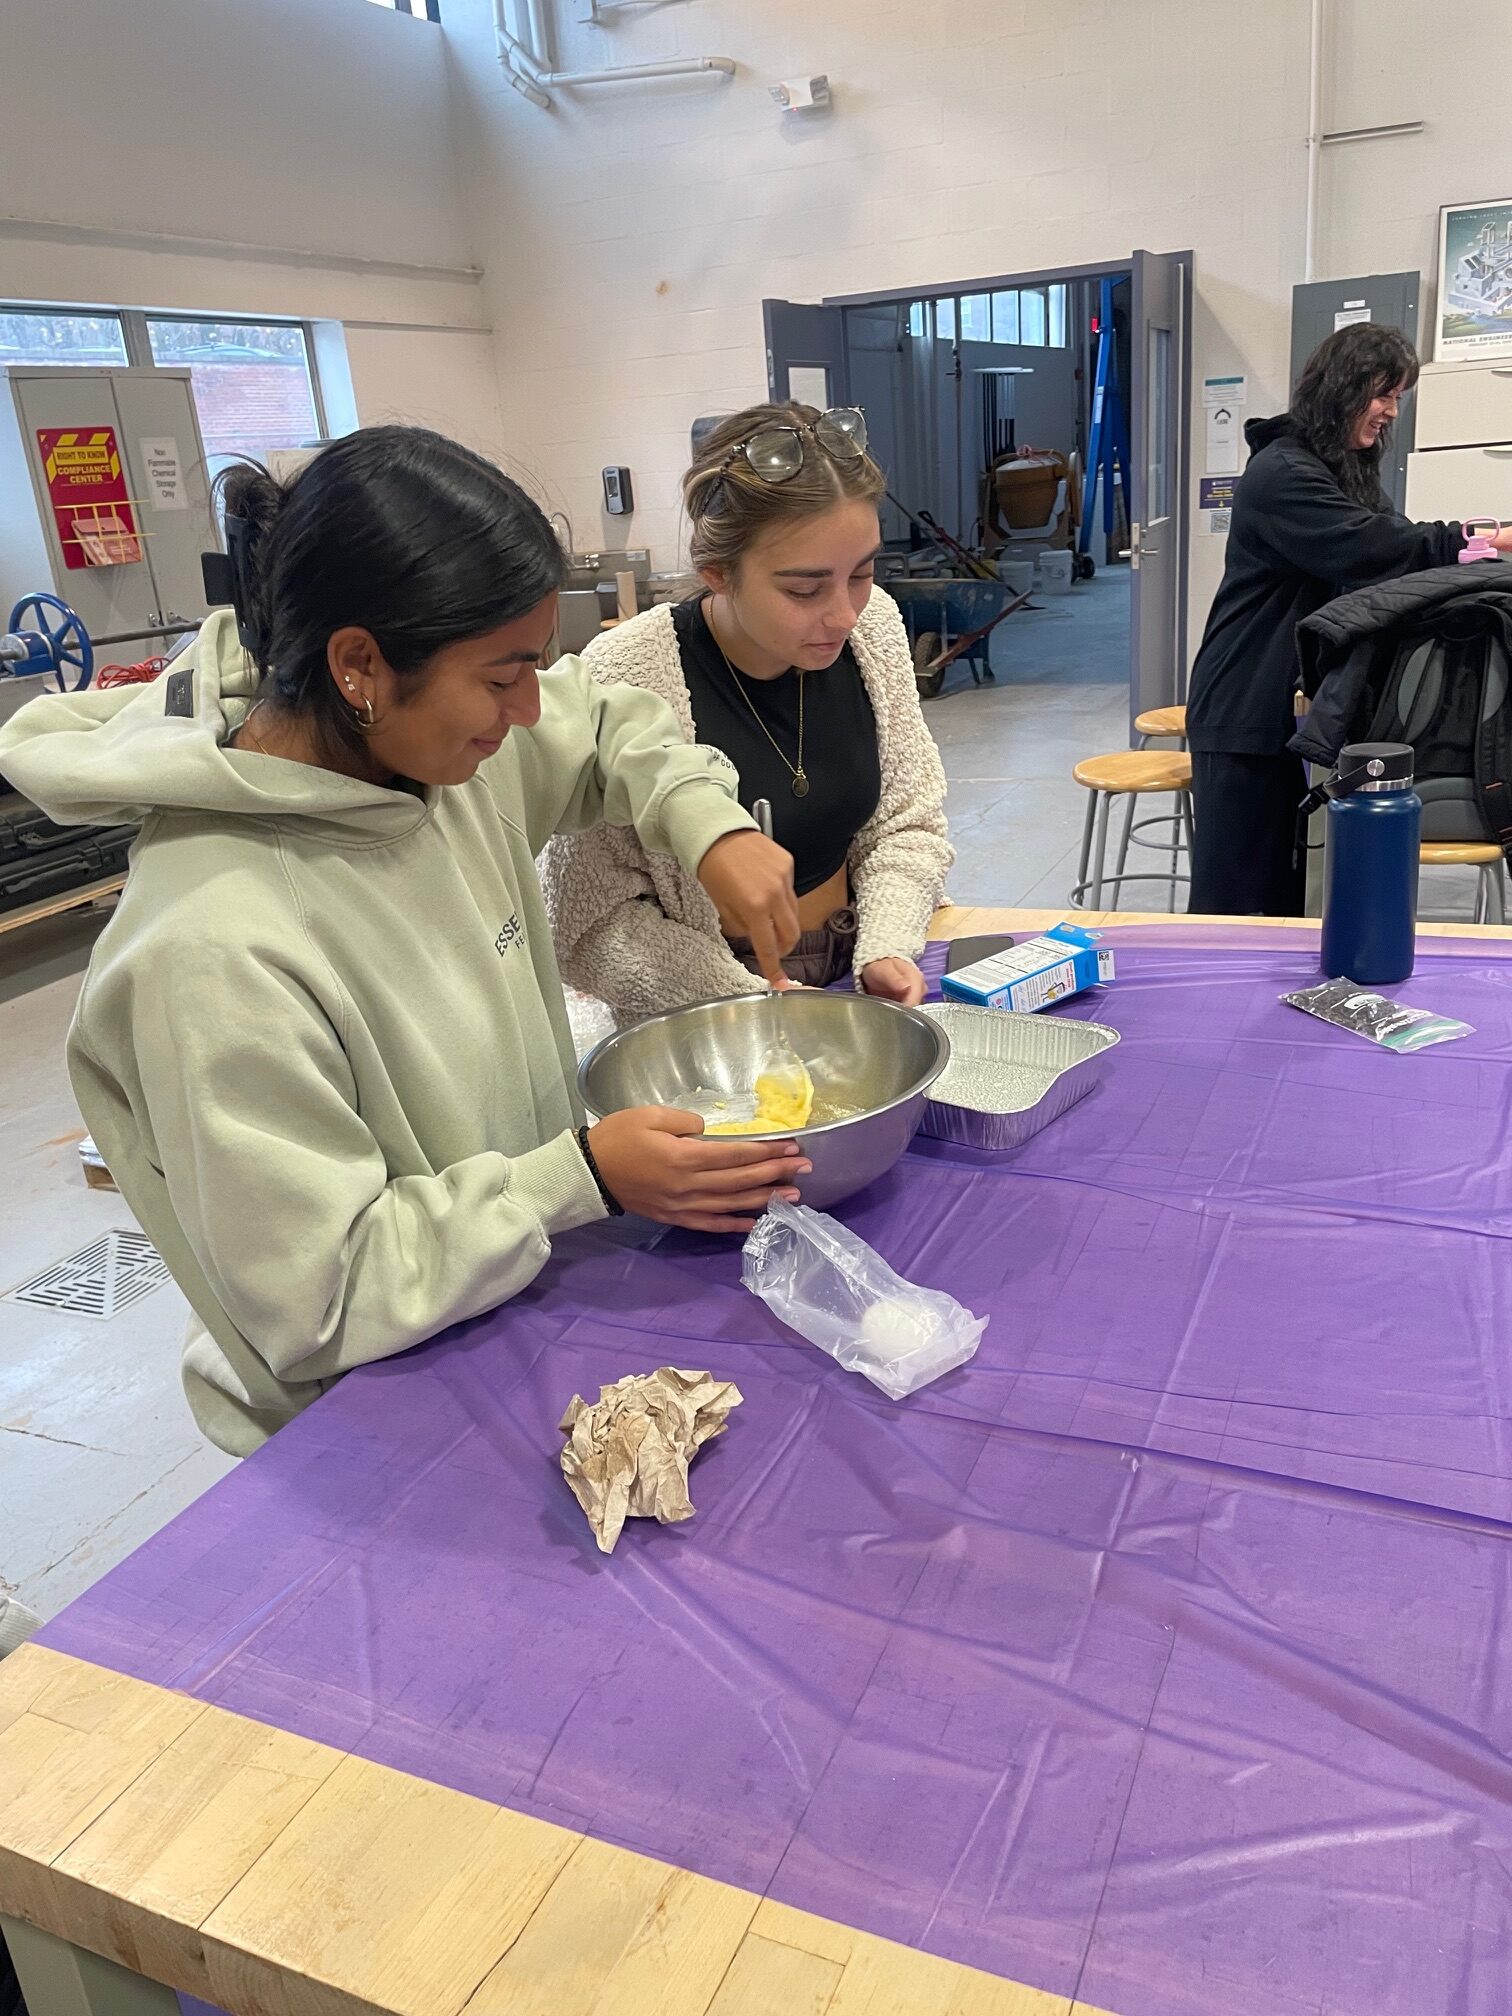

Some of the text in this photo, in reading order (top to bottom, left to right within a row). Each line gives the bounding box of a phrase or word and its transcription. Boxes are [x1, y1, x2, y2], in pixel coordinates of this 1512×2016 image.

[77, 451, 87, 459] TO
[87, 450, 106, 459] KNOW
[57, 464, 112, 475] COMPLIANCE
[70, 474, 103, 483] CENTER
[495, 911, 521, 958] ESSE
[515, 932, 525, 949] FE
